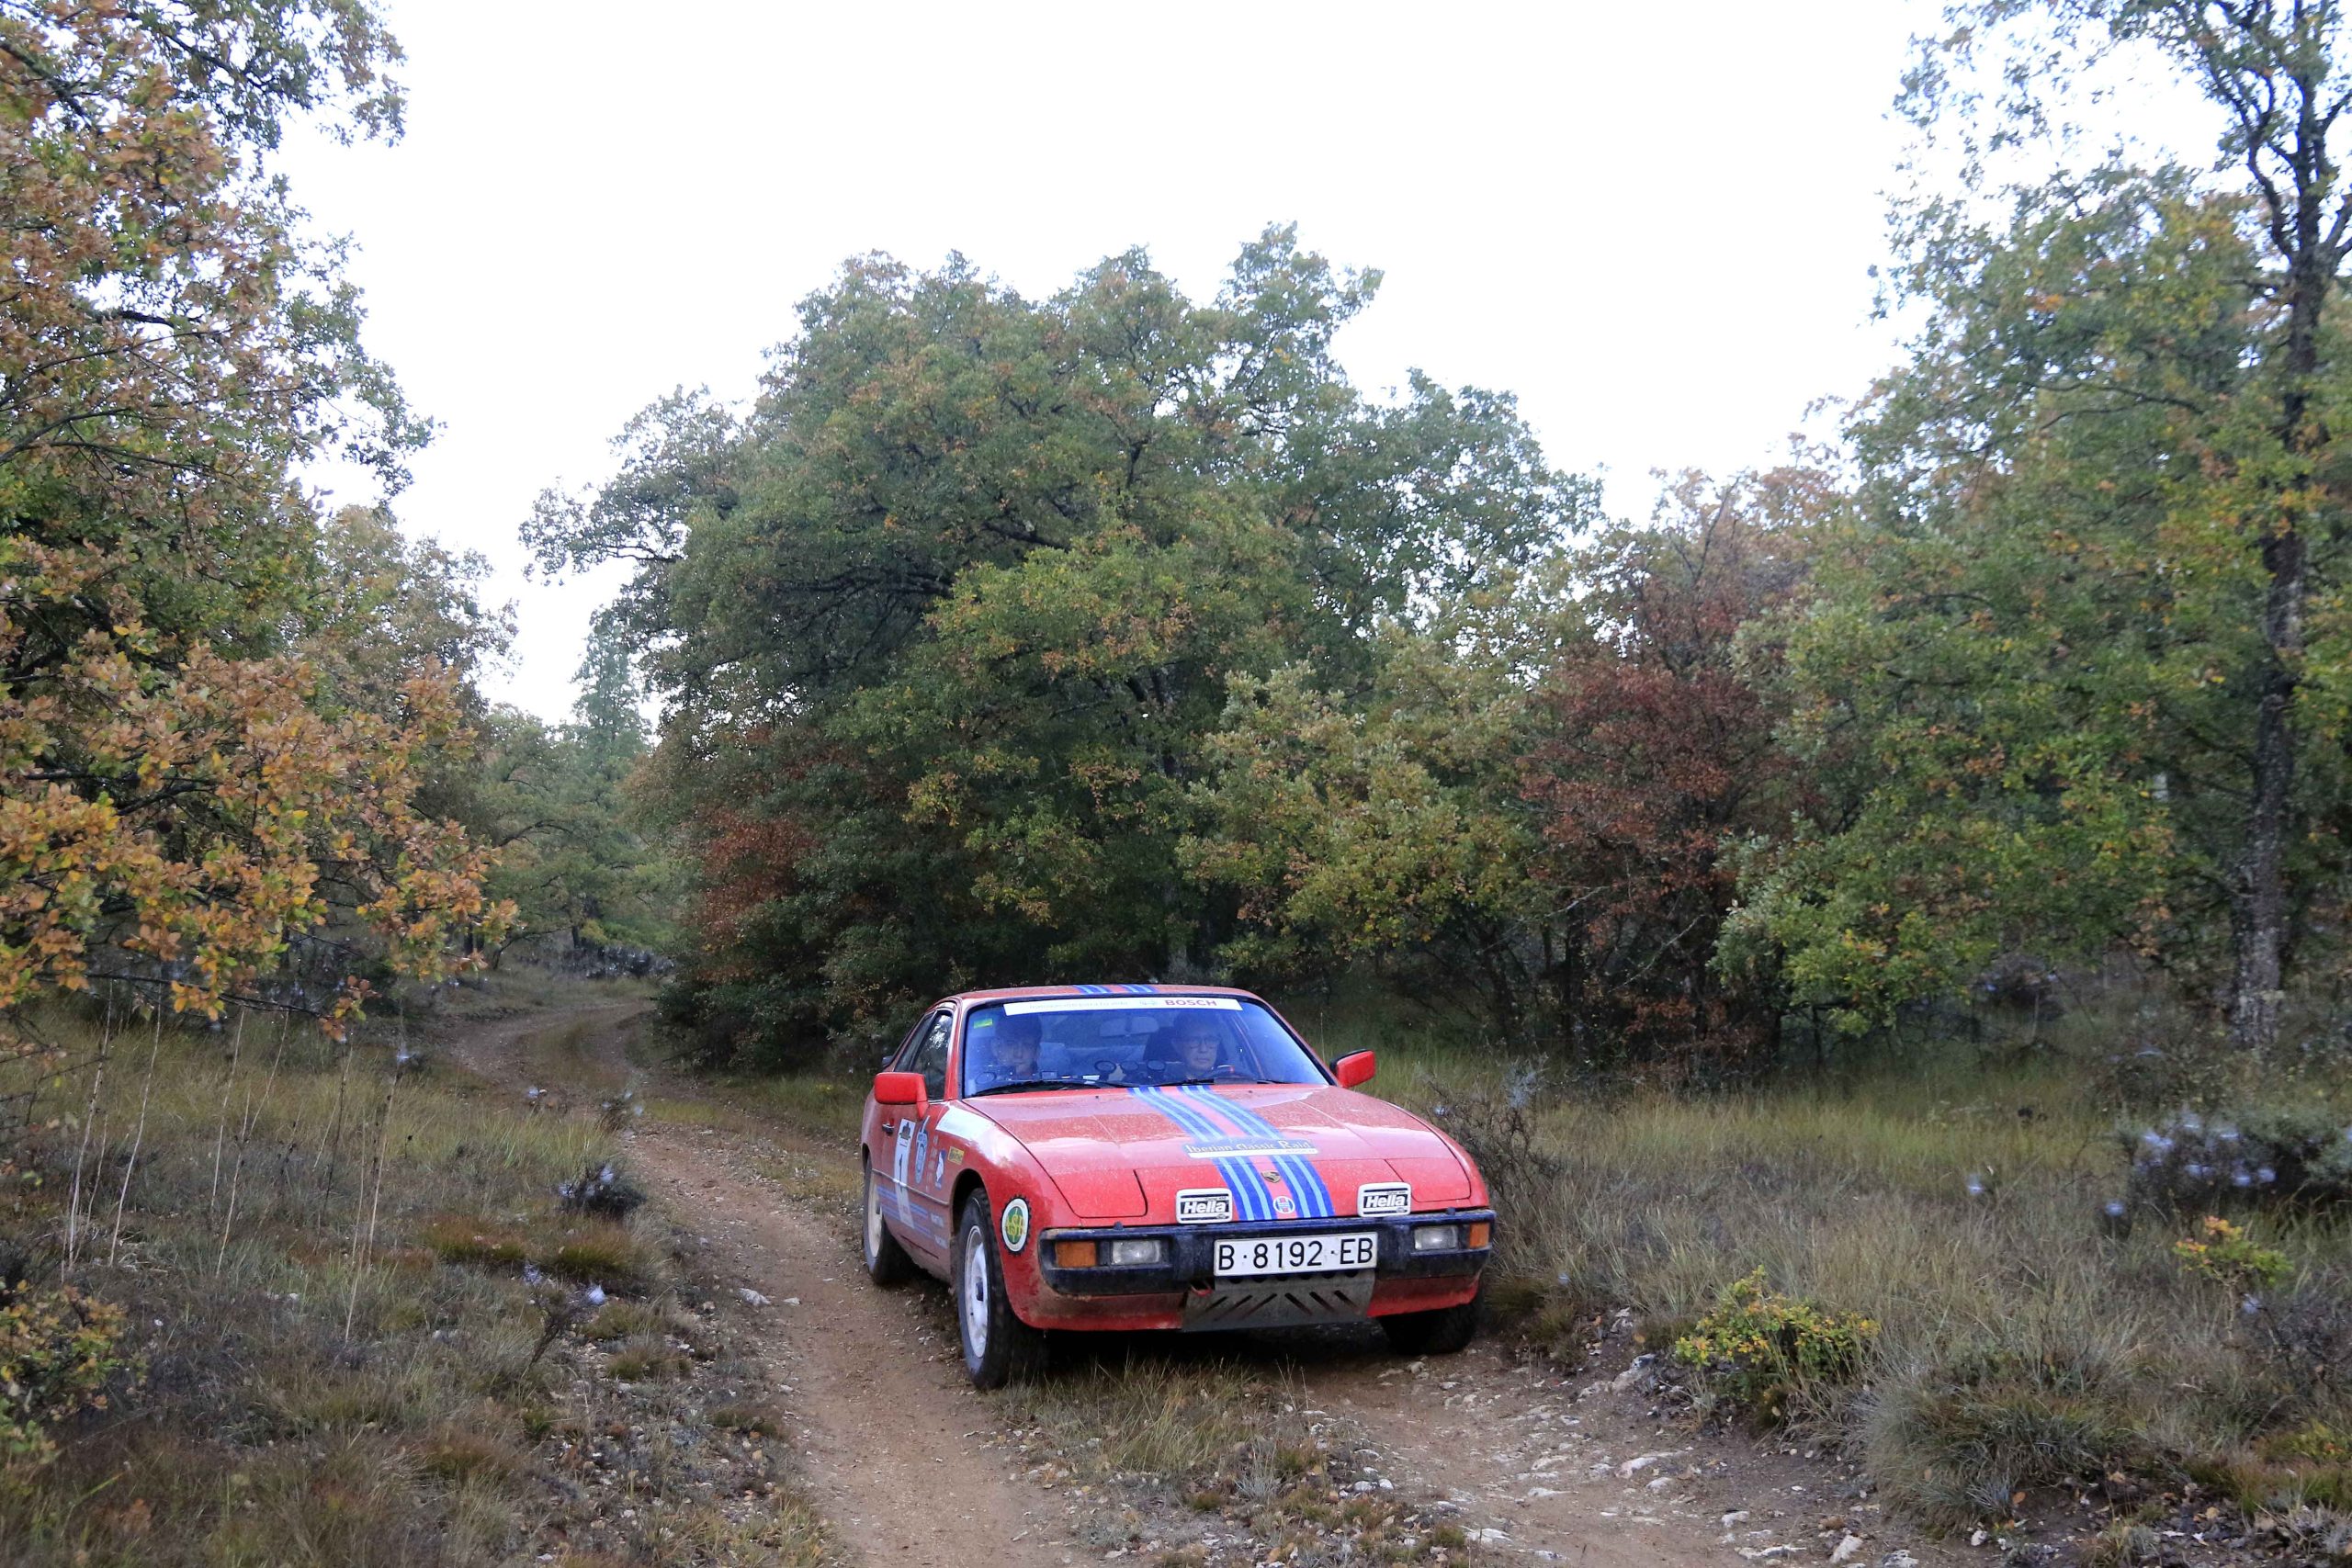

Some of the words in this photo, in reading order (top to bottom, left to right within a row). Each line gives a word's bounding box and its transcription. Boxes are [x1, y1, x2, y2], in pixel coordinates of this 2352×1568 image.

[1185, 1145, 1233, 1153] Iberian
[1278, 1140, 1311, 1149] Raid
[1183, 1201, 1227, 1213] Hella
[1365, 1194, 1406, 1208] Hella
